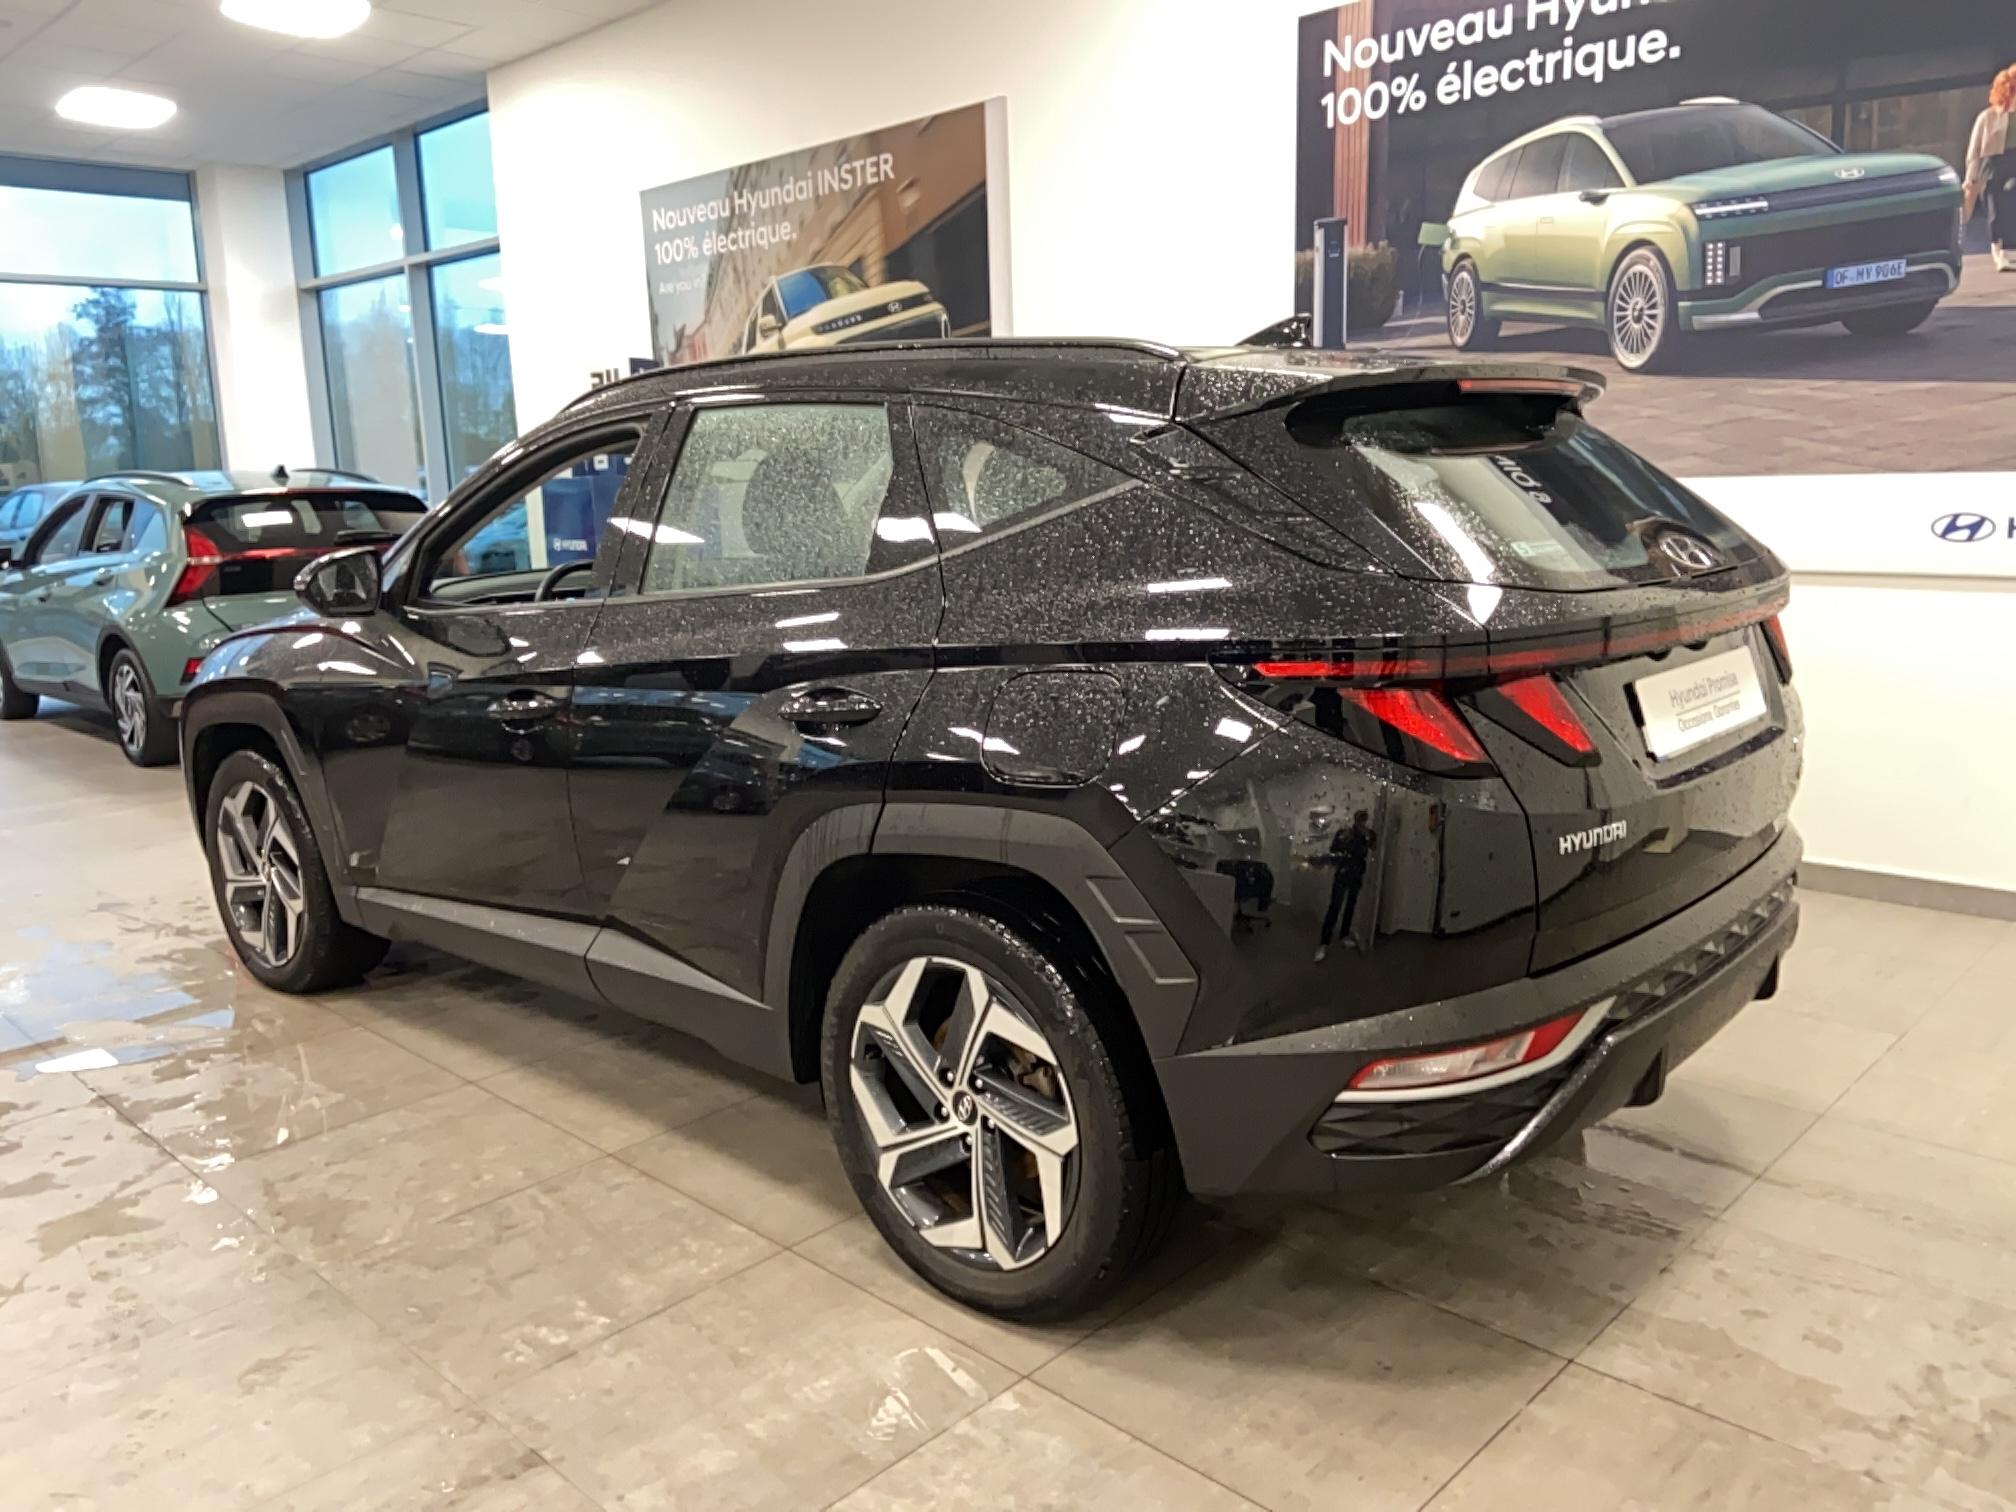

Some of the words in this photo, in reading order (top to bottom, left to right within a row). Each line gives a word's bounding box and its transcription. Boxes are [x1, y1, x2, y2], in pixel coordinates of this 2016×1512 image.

[1323, 4, 1513, 78] Nouveau
[1527, 0, 1650, 31] Hy
[1321, 72, 1427, 129] 100%
[1437, 29, 1682, 104] électrique.
[653, 198, 729, 232] Nouveau
[734, 171, 813, 217] Hyundai
[818, 153, 896, 195] INSTER
[655, 236, 698, 265] 100%
[703, 221, 797, 256] électrique.
[1559, 819, 1627, 855] HYUNDAI
